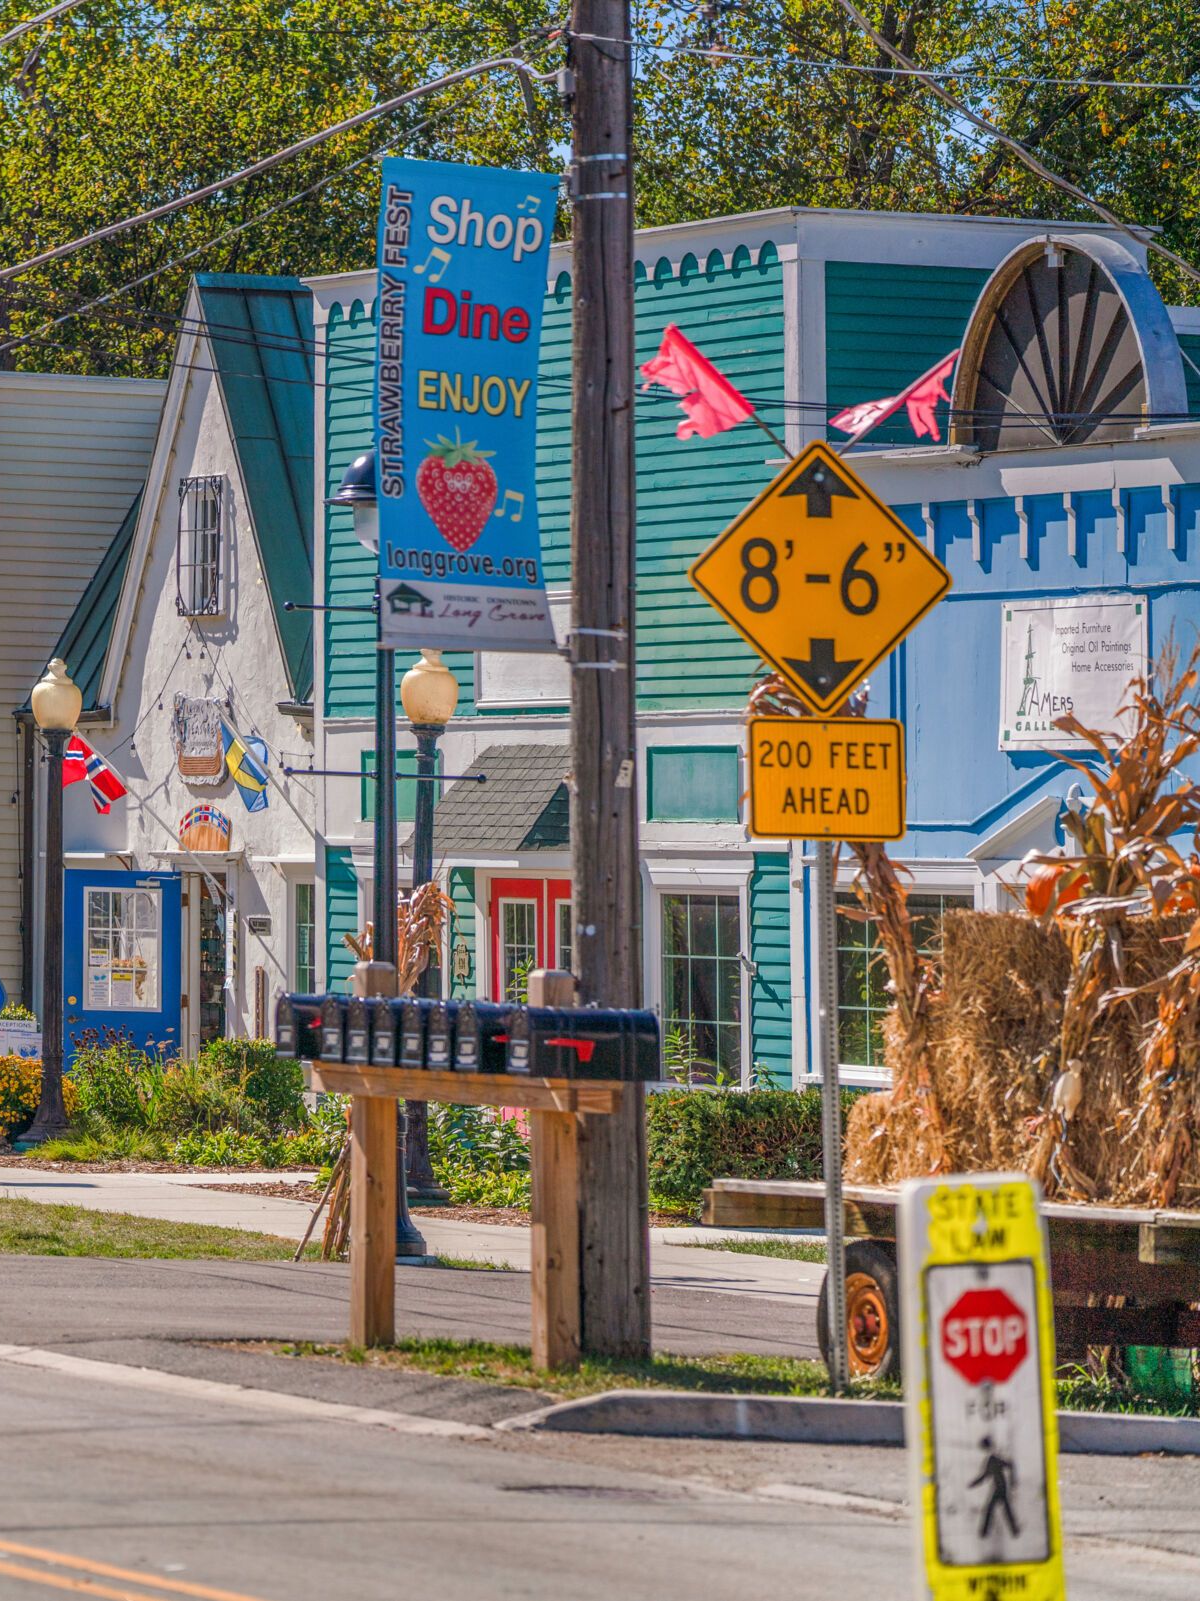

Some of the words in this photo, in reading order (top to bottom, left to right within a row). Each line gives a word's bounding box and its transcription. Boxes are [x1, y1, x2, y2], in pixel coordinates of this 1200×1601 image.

[382, 184, 413, 268] FEST
[427, 196, 543, 262] Shop
[422, 286, 530, 343] Dine
[379, 271, 406, 499] STRAWBERRY
[417, 370, 531, 417] ENJOY
[386, 540, 538, 584] longgrove.org
[438, 603, 482, 627] Long
[488, 604, 545, 622] Grove
[443, 594, 479, 603] HISTORIC
[486, 597, 537, 606] DOWNTOWN
[1055, 622, 1079, 636] Imported
[1081, 622, 1112, 634] Furniture
[1062, 642, 1085, 656] Original
[1088, 640, 1099, 653] Oil
[1101, 640, 1131, 654] Paintings
[1071, 661, 1091, 672] Home
[1094, 659, 1134, 672] Accessories
[1015, 721, 1056, 731] GALLE
[759, 740, 812, 768] 200
[829, 742, 892, 770] FEET
[781, 787, 870, 815] AHEAD
[932, 1189, 1020, 1220] STATE
[949, 1227, 1007, 1255] LAW
[945, 1316, 1024, 1358] STOP
